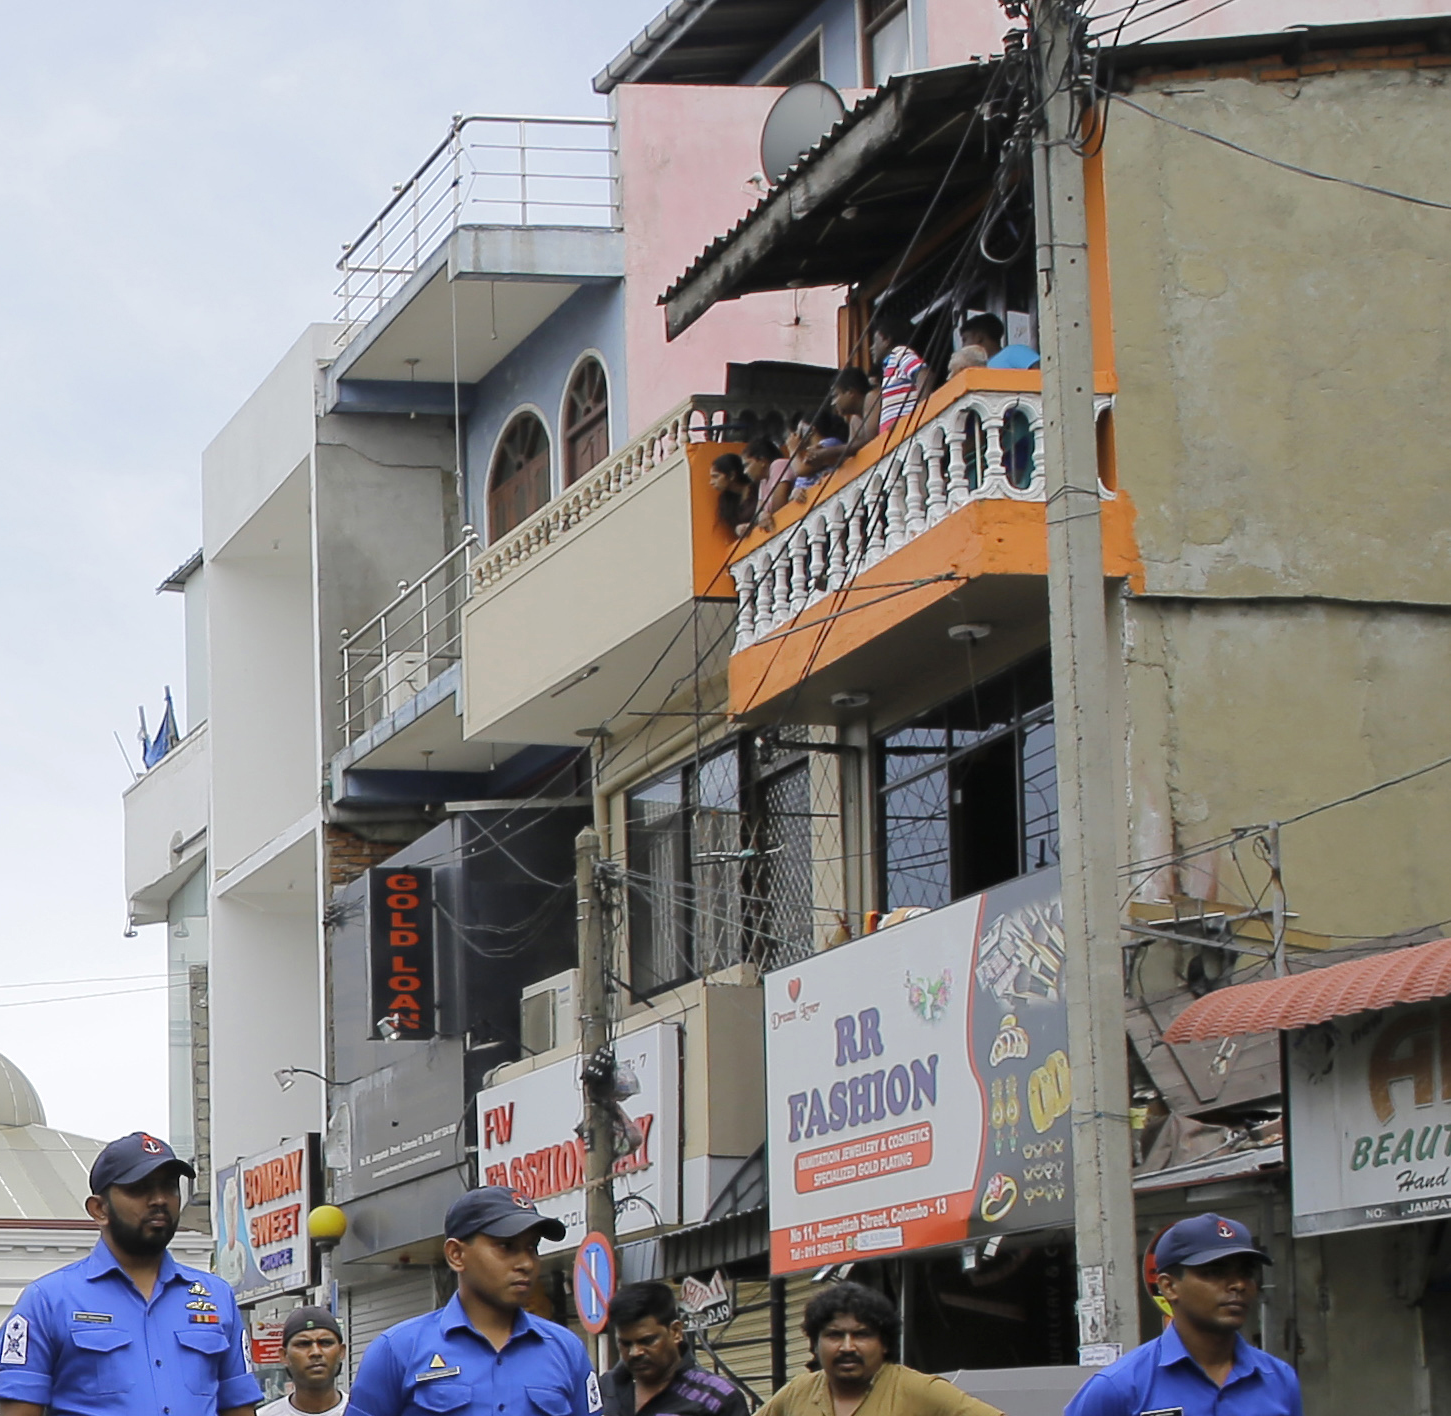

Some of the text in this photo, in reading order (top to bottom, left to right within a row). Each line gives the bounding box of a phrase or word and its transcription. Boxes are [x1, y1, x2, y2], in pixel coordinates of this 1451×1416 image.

[386, 873, 420, 947] GOLD
[388, 956, 422, 1030] LOAN
[835, 1007, 884, 1067] RR
[788, 1054, 939, 1142] FASHION
[484, 1102, 514, 1150] FW
[841, 1140, 879, 1163] JEWELLERY
[880, 1138, 887, 1151] &
[888, 1127, 930, 1150] COSMETICS
[244, 1149, 304, 1209] BOMBAY
[813, 1152, 913, 1187] SPECIALIZED GOLD PLATING
[1396, 1167, 1449, 1192] Hand
[251, 1204, 301, 1248] SWEET
[861, 1210, 889, 1229] Street,
[891, 1201, 929, 1223] Colombo
[935, 1197, 947, 1214] 13
